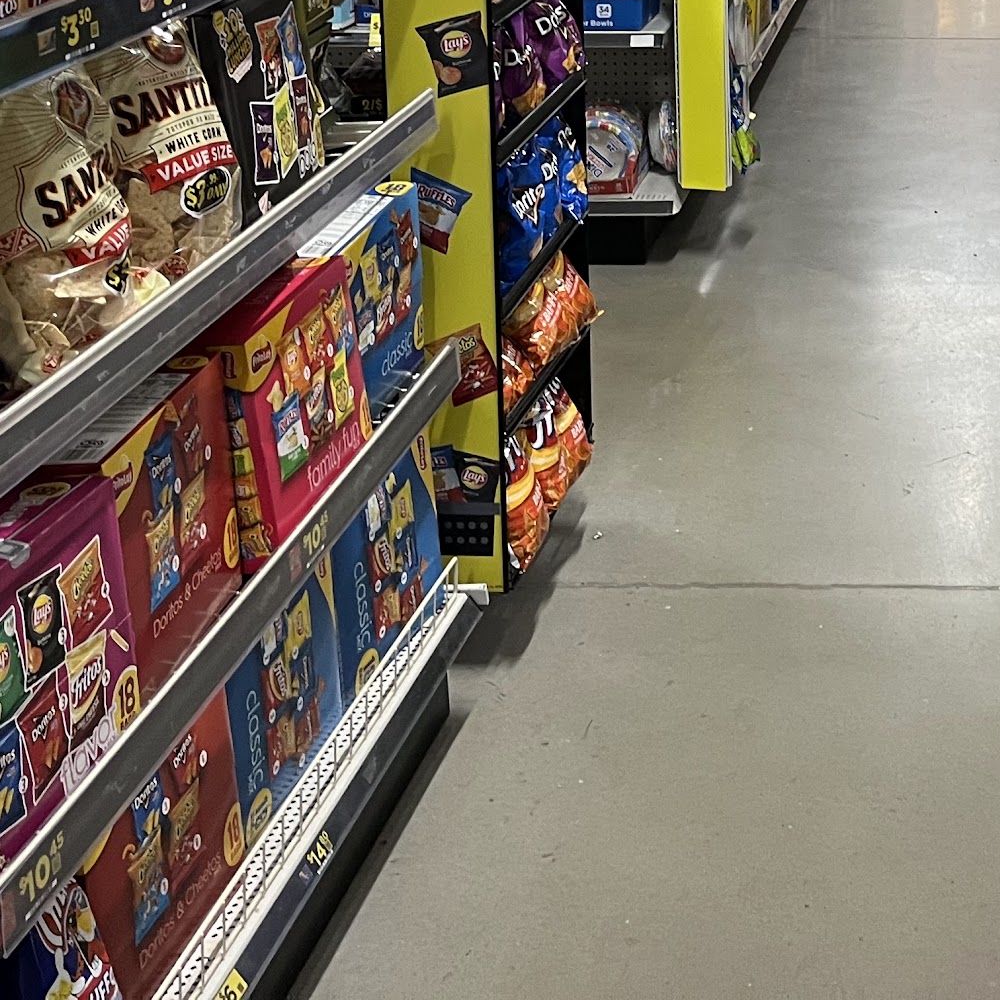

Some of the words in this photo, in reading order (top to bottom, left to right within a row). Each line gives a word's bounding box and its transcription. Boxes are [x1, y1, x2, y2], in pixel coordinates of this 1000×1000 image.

[590, 19, 614, 27] Bowls
[165, 131, 200, 155] WHITE
[202, 126, 222, 141] CORN
[156, 150, 211, 182] VALUE
[211, 143, 235, 162] SIZE
[417, 183, 457, 208] RUFFLES
[81, 222, 131, 261] VALUE
[381, 329, 414, 377] classic
[307, 445, 343, 493] family
[342, 420, 362, 449] fun
[153, 597, 184, 638] Doritos
[191, 547, 222, 591] Cheetos
[353, 560, 372, 650] classic
[71, 655, 103, 708] Fritos
[119, 674, 136, 720] 18
[31, 705, 57, 742] Doritos
[172, 733, 193, 769] Doritos
